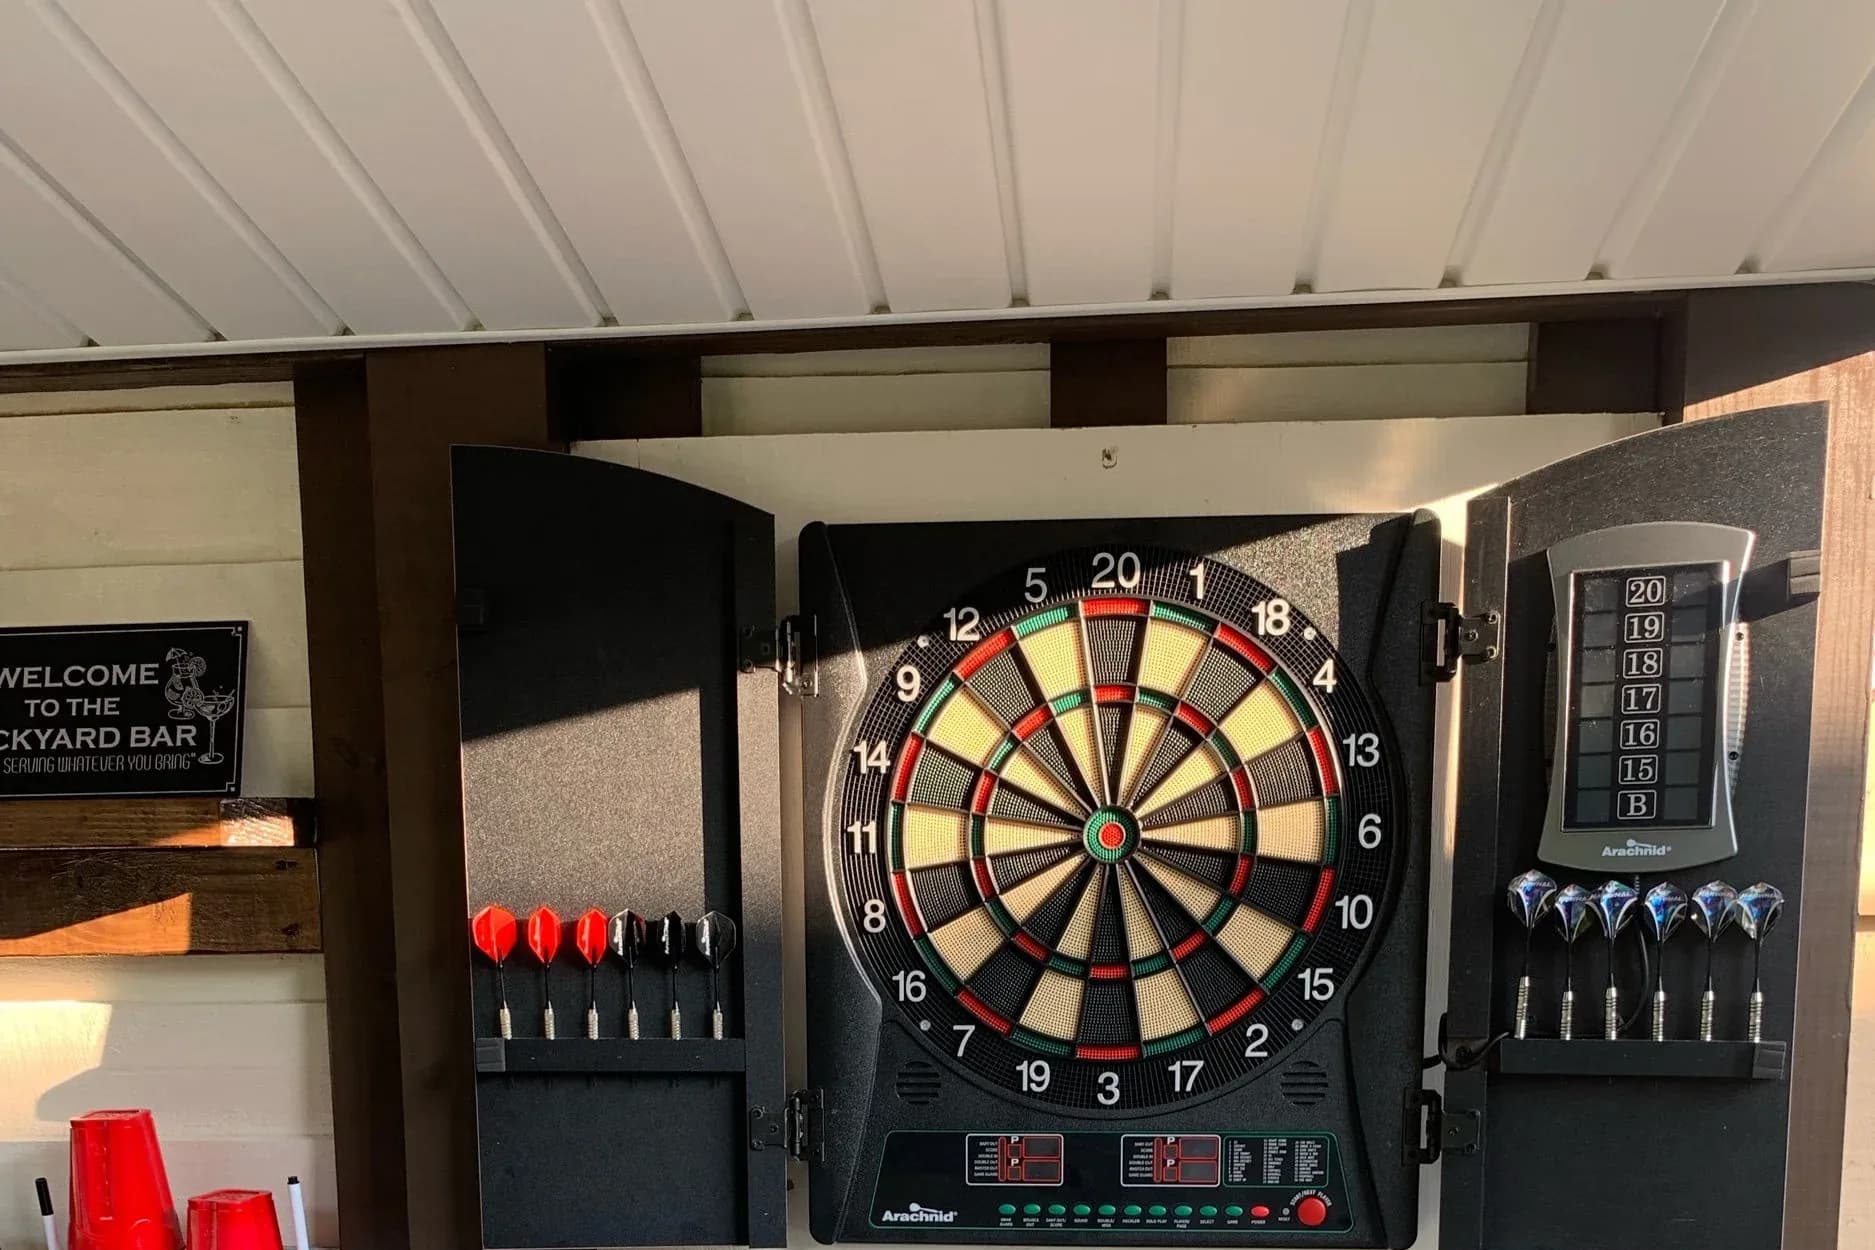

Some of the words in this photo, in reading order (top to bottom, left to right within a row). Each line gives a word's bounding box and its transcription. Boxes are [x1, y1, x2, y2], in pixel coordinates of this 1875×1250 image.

[1024, 567, 1048, 602] 5
[1091, 552, 1141, 588] 20
[1189, 563, 1205, 599] 1
[1630, 580, 1662, 603] 20
[943, 607, 981, 641] 12
[1252, 598, 1291, 636] 18
[1629, 616, 1660, 640] 19
[0, 664, 159, 689] WELCOME
[1312, 658, 1337, 693] 4
[1628, 652, 1658, 676] 18
[896, 665, 921, 702] 9
[1626, 688, 1657, 711] 17
[24, 698, 60, 717] TO
[66, 697, 120, 716] THE
[0, 726, 121, 751] CKYARD
[130, 725, 197, 748] BAR
[1343, 733, 1380, 767] 13
[1625, 724, 1655, 746] 16
[3, 756, 54, 774] SERVING
[58, 755, 124, 773] WHATEVER
[128, 754, 152, 771] YOU
[854, 740, 891, 774] 14
[1623, 759, 1653, 782] 15
[1628, 794, 1647, 815] B
[847, 820, 877, 854] 11
[1358, 813, 1382, 849] 6
[863, 899, 886, 933] 8
[1335, 894, 1374, 929] 10
[892, 970, 927, 1002] 16
[1298, 967, 1335, 1001] 15
[953, 1024, 976, 1057] 7
[1244, 1023, 1269, 1058] 2
[1015, 1059, 1050, 1093] 19
[1097, 1071, 1120, 1105] 3
[1168, 1060, 1204, 1092] 17
[1011, 1136, 1019, 1144] P
[1167, 1136, 1175, 1145] P
[1011, 1159, 1019, 1167] P
[1167, 1159, 1175, 1168] P
[882, 1210, 954, 1222] Arachnid
